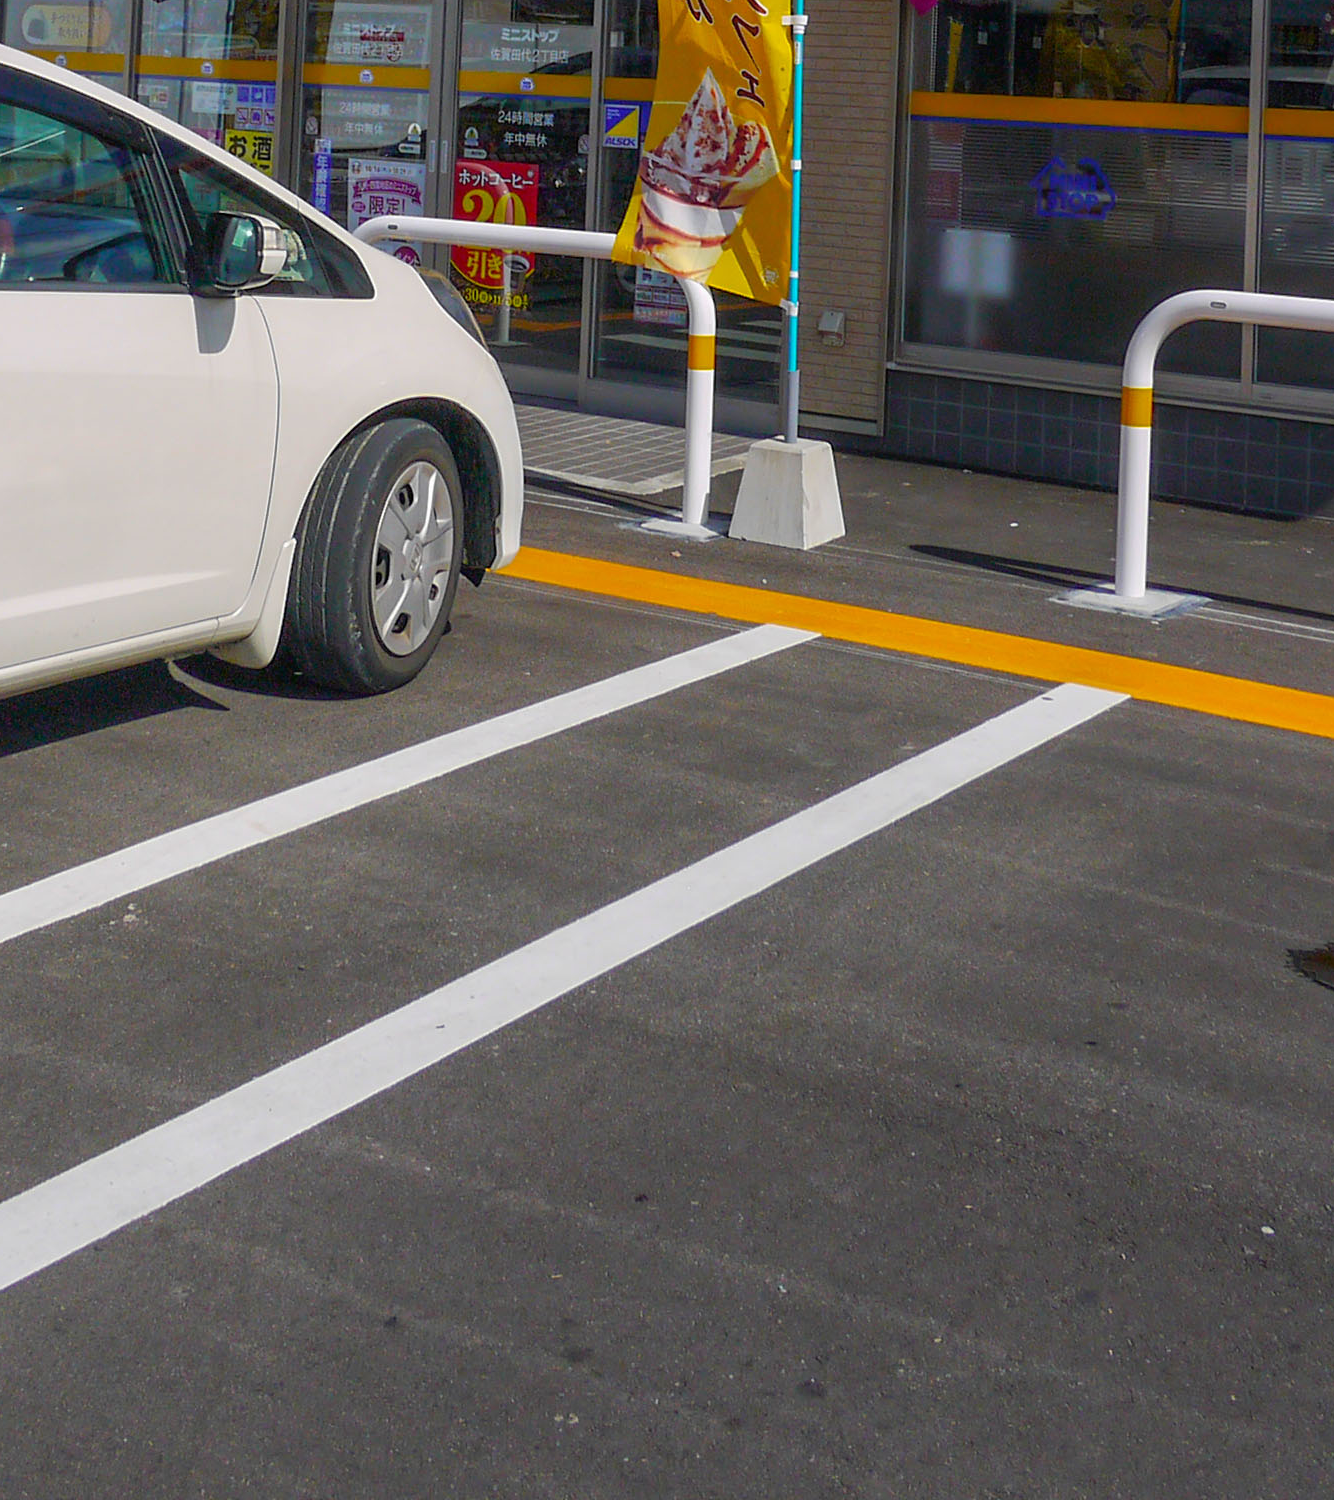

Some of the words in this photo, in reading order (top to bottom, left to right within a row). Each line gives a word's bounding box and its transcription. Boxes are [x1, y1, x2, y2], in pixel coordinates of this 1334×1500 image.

[500, 27, 561, 43] ミニストップ
[498, 110, 555, 128] 24時間営業
[229, 135, 272, 160] お酒
[503, 131, 548, 148] 年中無休
[605, 136, 636, 147] ALSOK
[458, 168, 534, 189] ホットコーヒー
[1046, 190, 1099, 211] STOP
